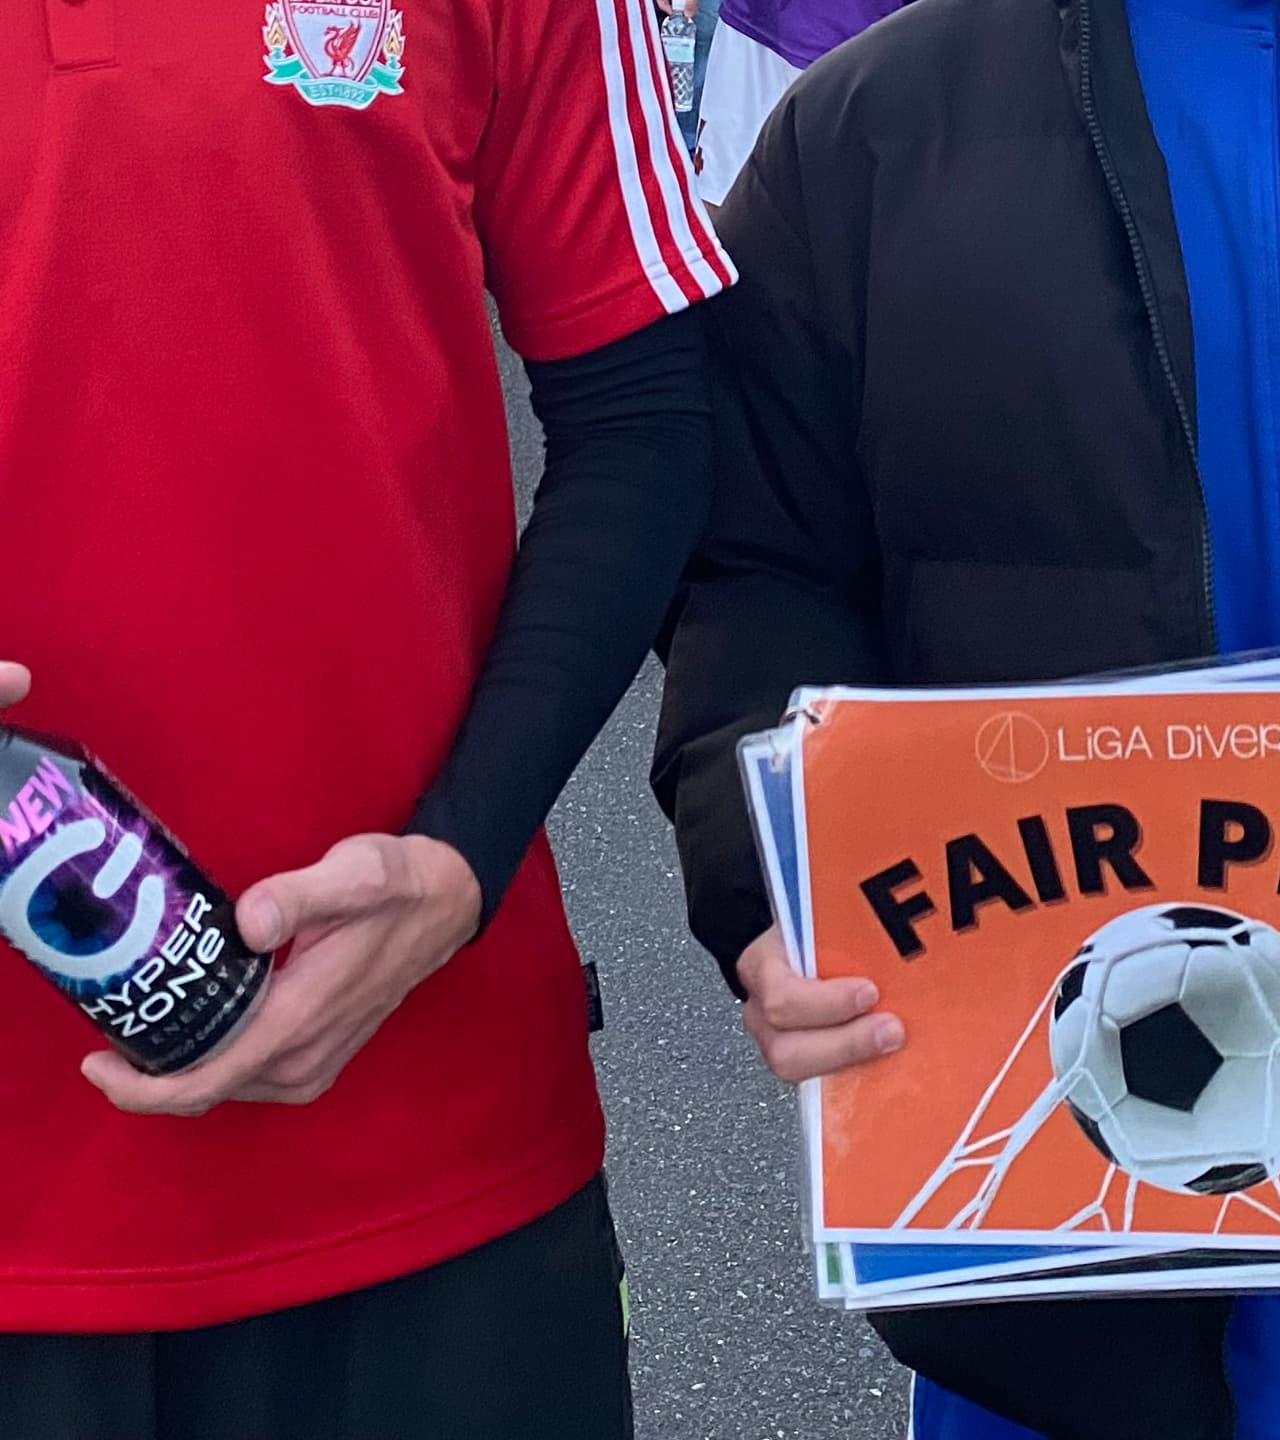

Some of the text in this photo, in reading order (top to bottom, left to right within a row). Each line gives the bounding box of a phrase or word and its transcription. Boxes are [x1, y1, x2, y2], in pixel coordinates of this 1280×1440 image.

[291, 5, 380, 19] FOOTBALL CLUB
[859, 802, 1155, 961] FAIR
[79, 891, 213, 1020] HYPER
